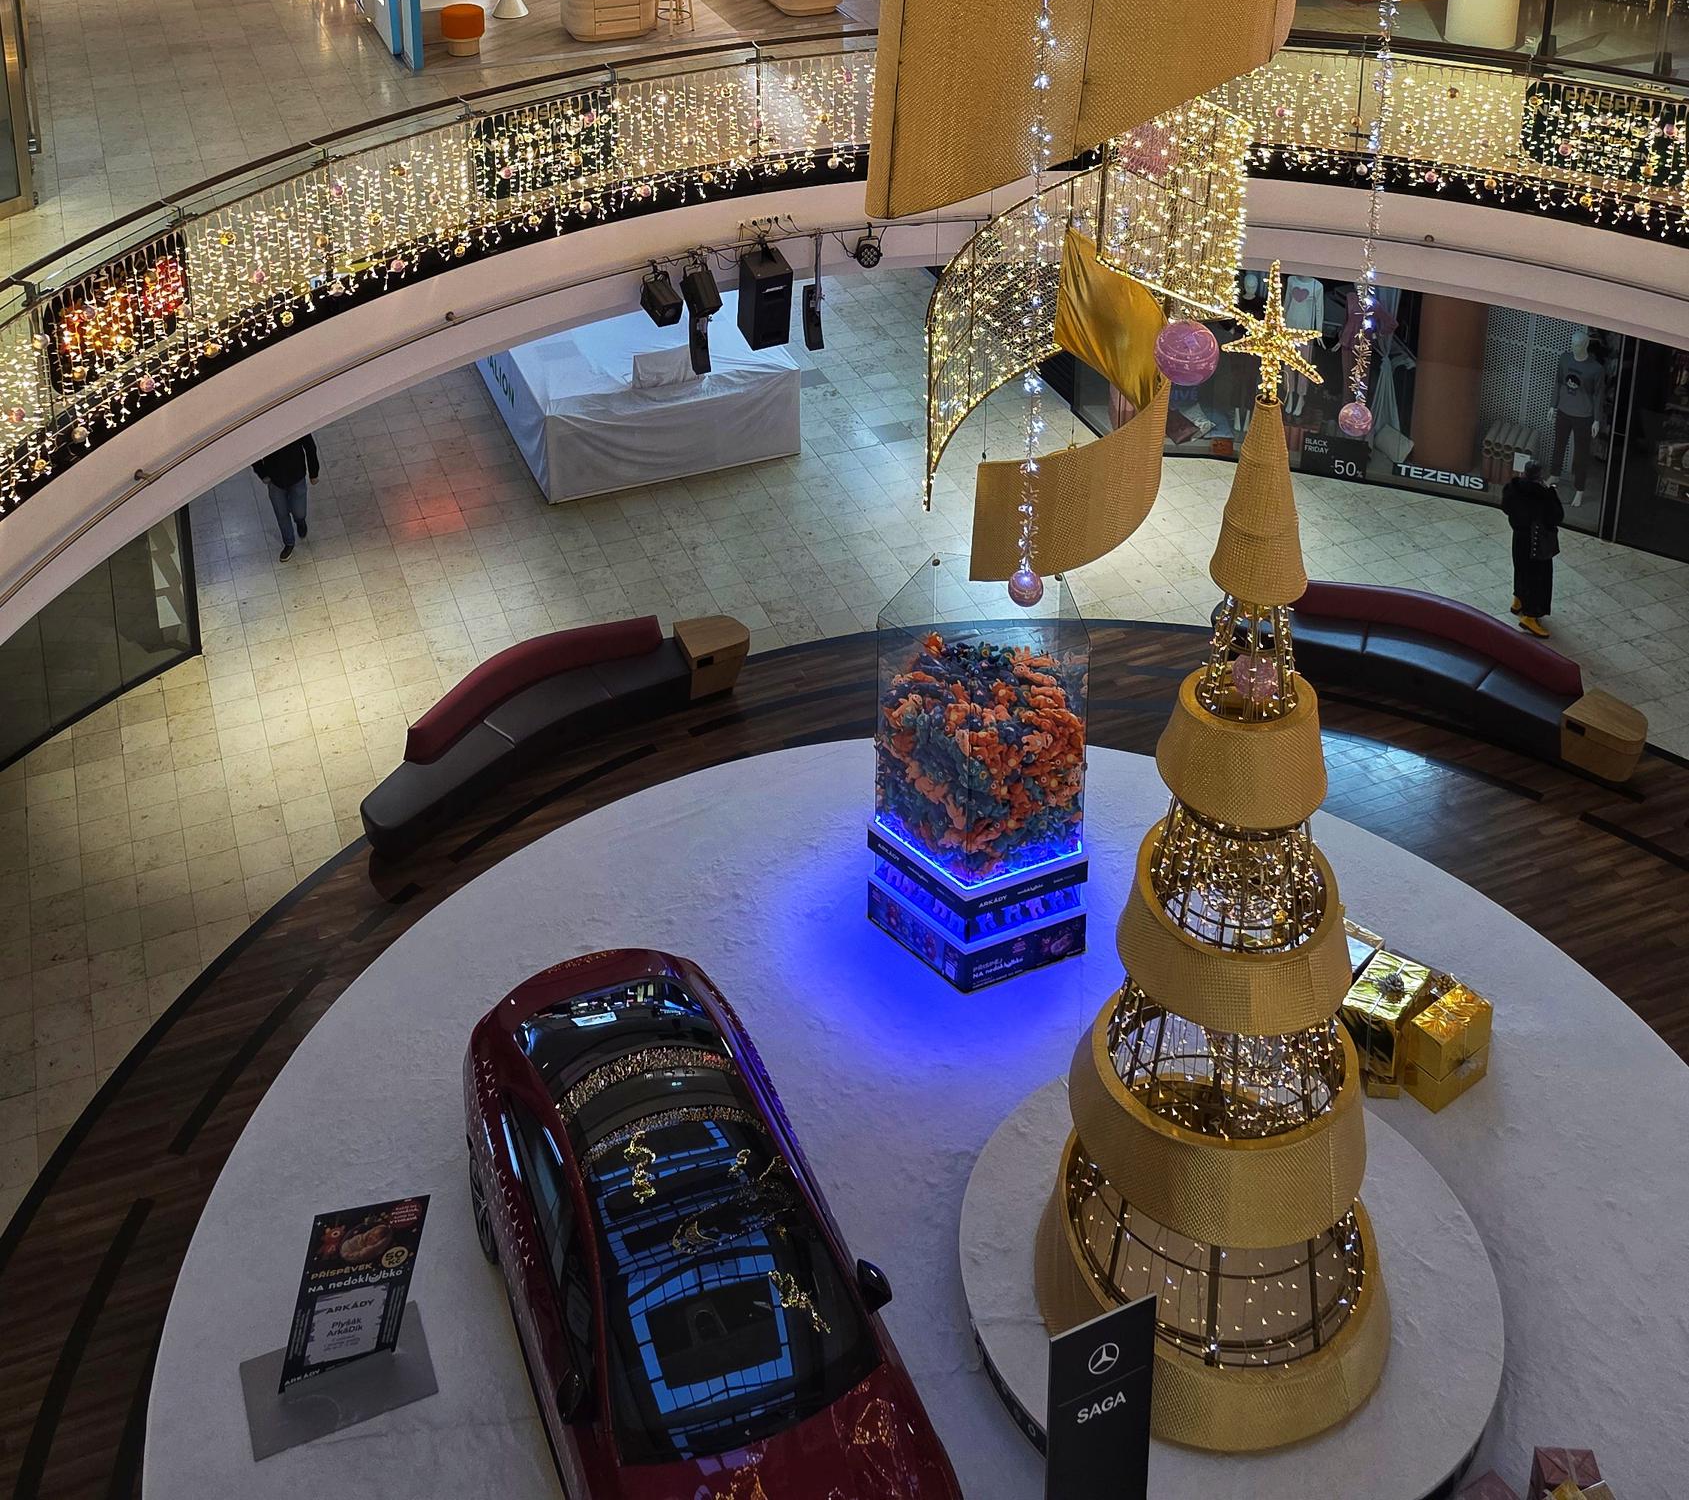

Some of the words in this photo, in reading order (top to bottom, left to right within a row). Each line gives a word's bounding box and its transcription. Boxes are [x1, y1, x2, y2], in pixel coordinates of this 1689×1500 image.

[1305, 437, 1328, 447] BLACK
[1304, 445, 1329, 455] FRIDAY
[1397, 464, 1484, 490] TEZENIS
[978, 895, 1008, 909] ARKÁDY
[385, 1250, 405, 1261] 50
[388, 1257, 401, 1266] Kč
[311, 1262, 373, 1280] PŘÍSPĚVEK
[307, 1285, 324, 1293] NA
[326, 1298, 375, 1314] ARKÁDY
[332, 1317, 362, 1329] Plyšák
[1077, 1391, 1126, 1424] SAGA
